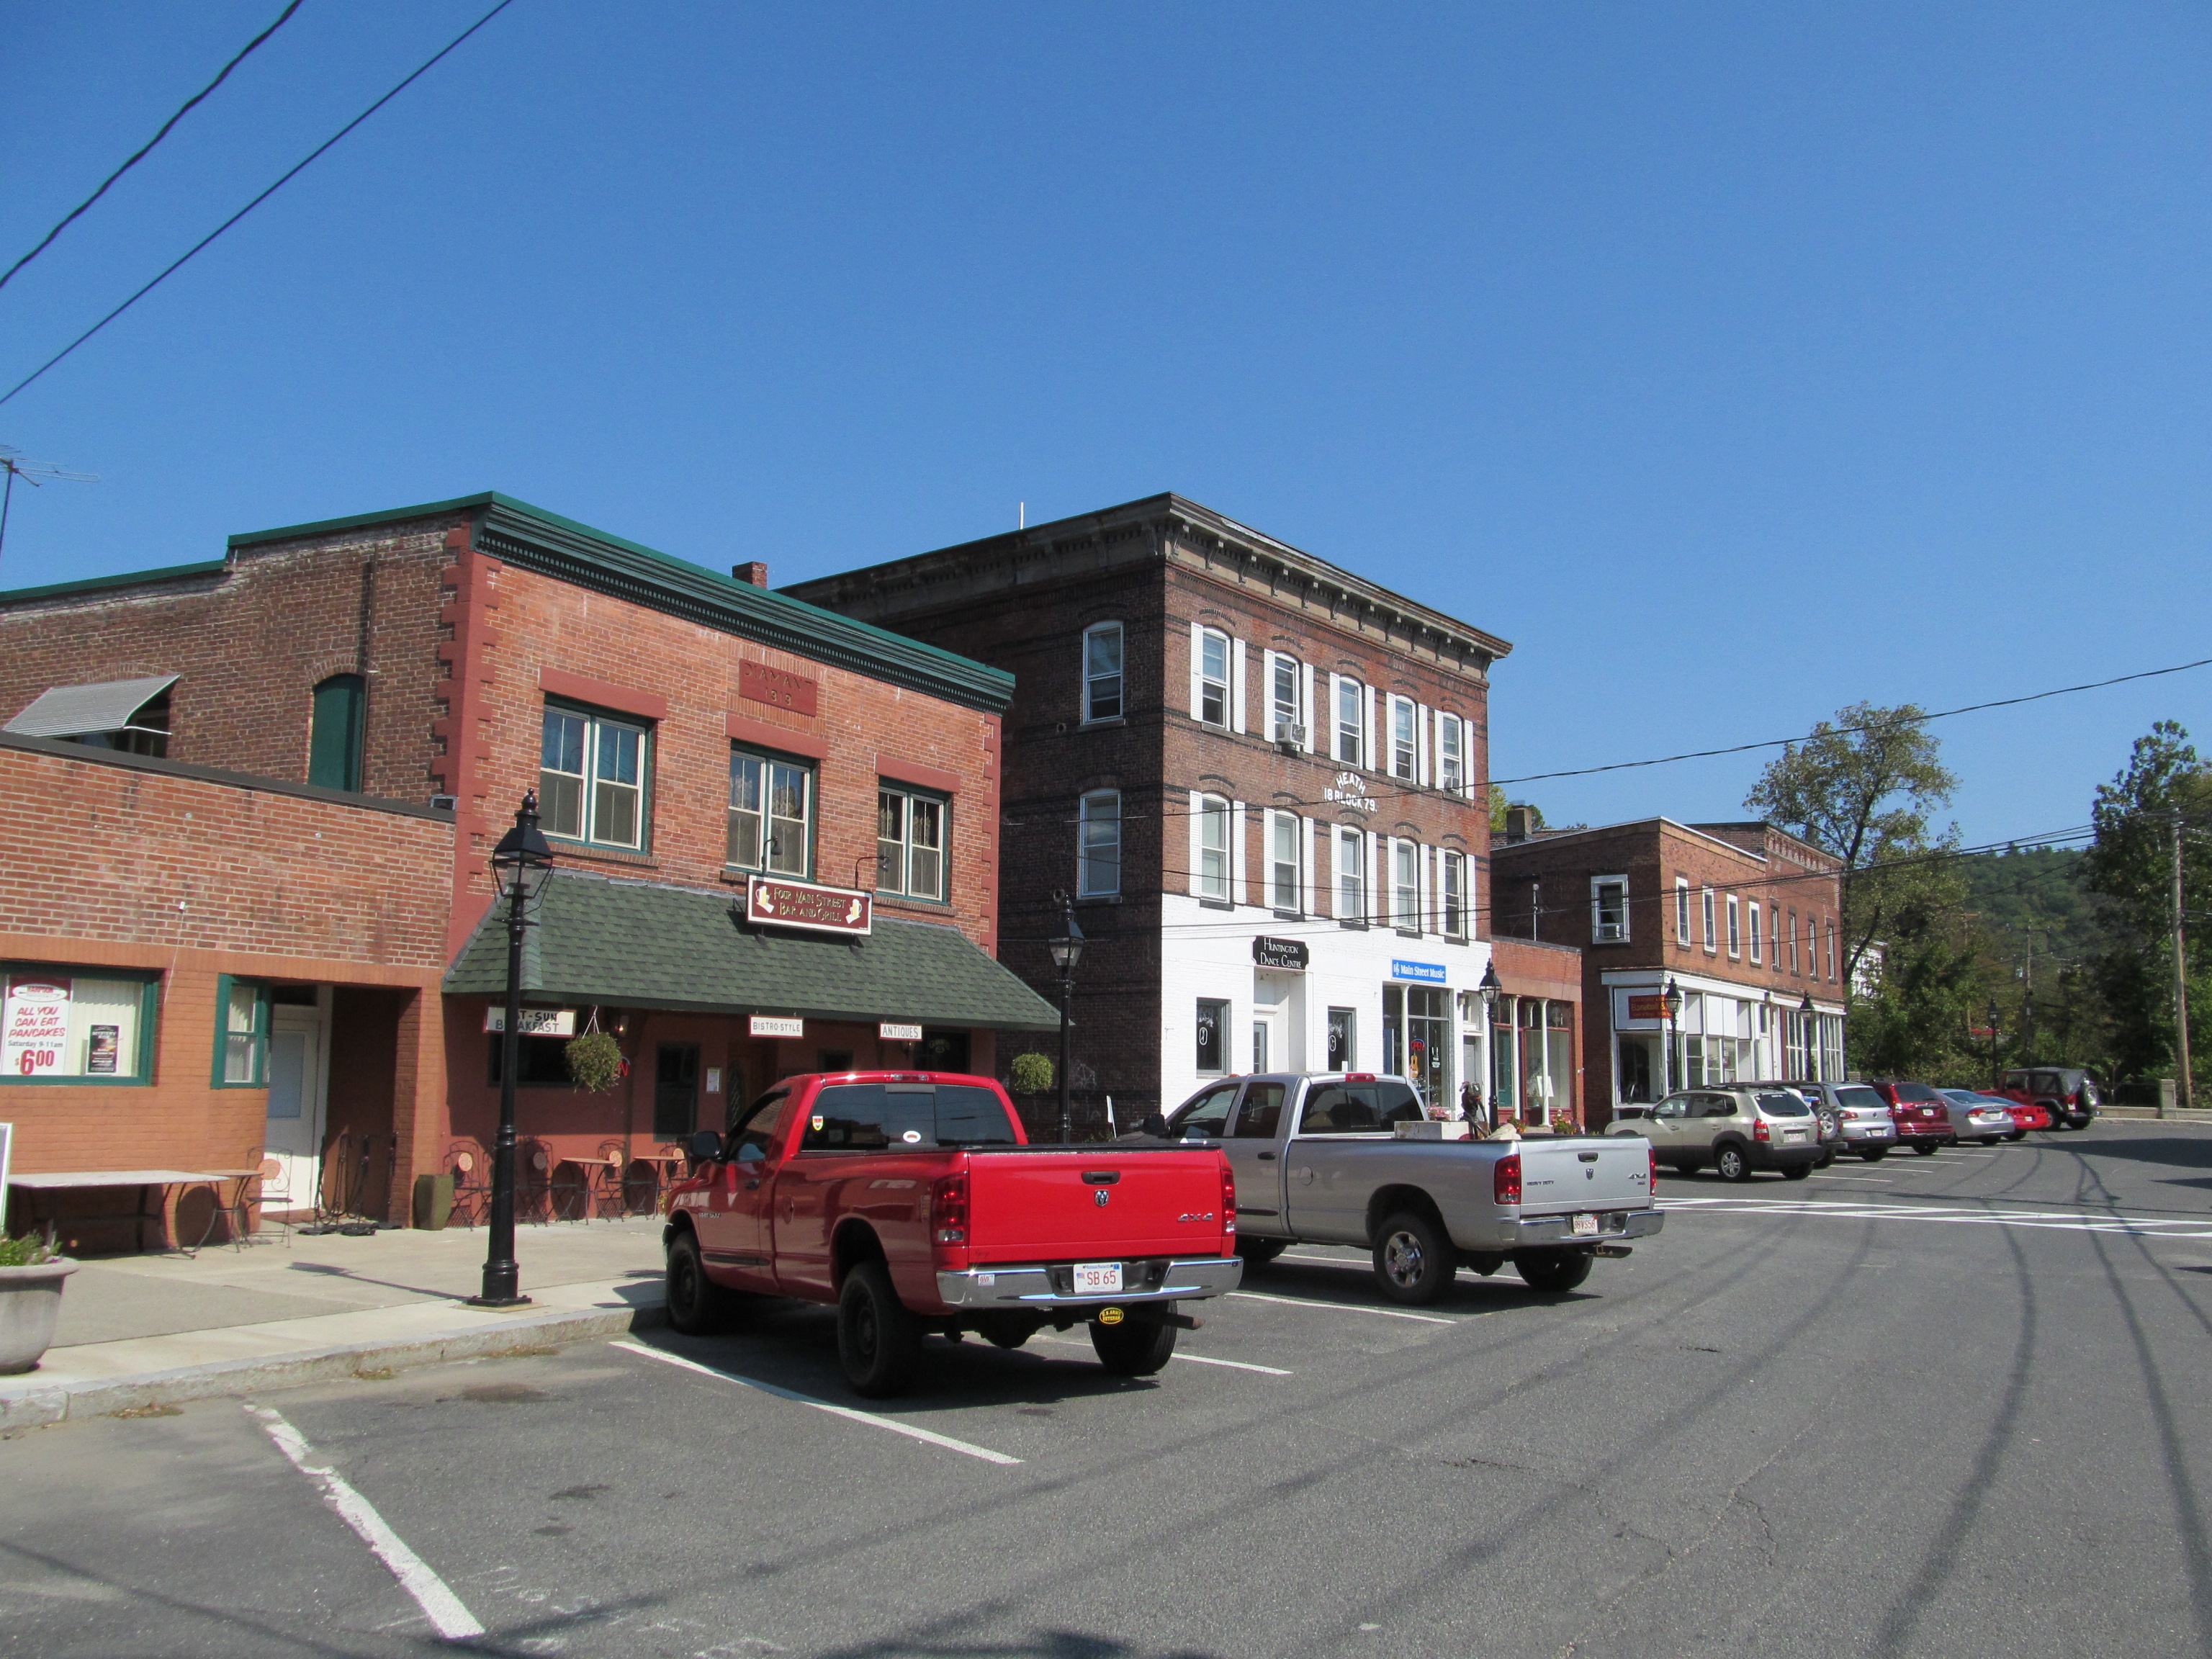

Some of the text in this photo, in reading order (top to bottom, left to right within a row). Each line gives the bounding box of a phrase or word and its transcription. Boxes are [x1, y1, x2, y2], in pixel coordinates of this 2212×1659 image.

[1336, 772, 1366, 795] HEATH
[1334, 789, 1362, 809] BLOCK
[773, 887, 791, 900] FOUR
[816, 894, 846, 909] STREET
[799, 908, 817, 918] AND
[817, 908, 842, 922] GRILL
[1264, 938, 1299, 954] HUNTINGTON
[1260, 952, 1302, 969] DANCE CENTRE
[1401, 964, 1445, 979] Main Street Music
[17, 1007, 59, 1016] ALL YOU
[518, 1010, 557, 1022] T-SUN
[15, 1017, 60, 1027] CAN EAT
[495, 1019, 559, 1033] BAKFAST
[752, 1021, 801, 1032] BISTRO-STYLE
[9, 1028, 66, 1038] PANCAKES
[882, 1025, 919, 1038] ANTIQUES
[1177, 1213, 1214, 1222] 4X4
[1087, 1270, 1116, 1285] SB 65
